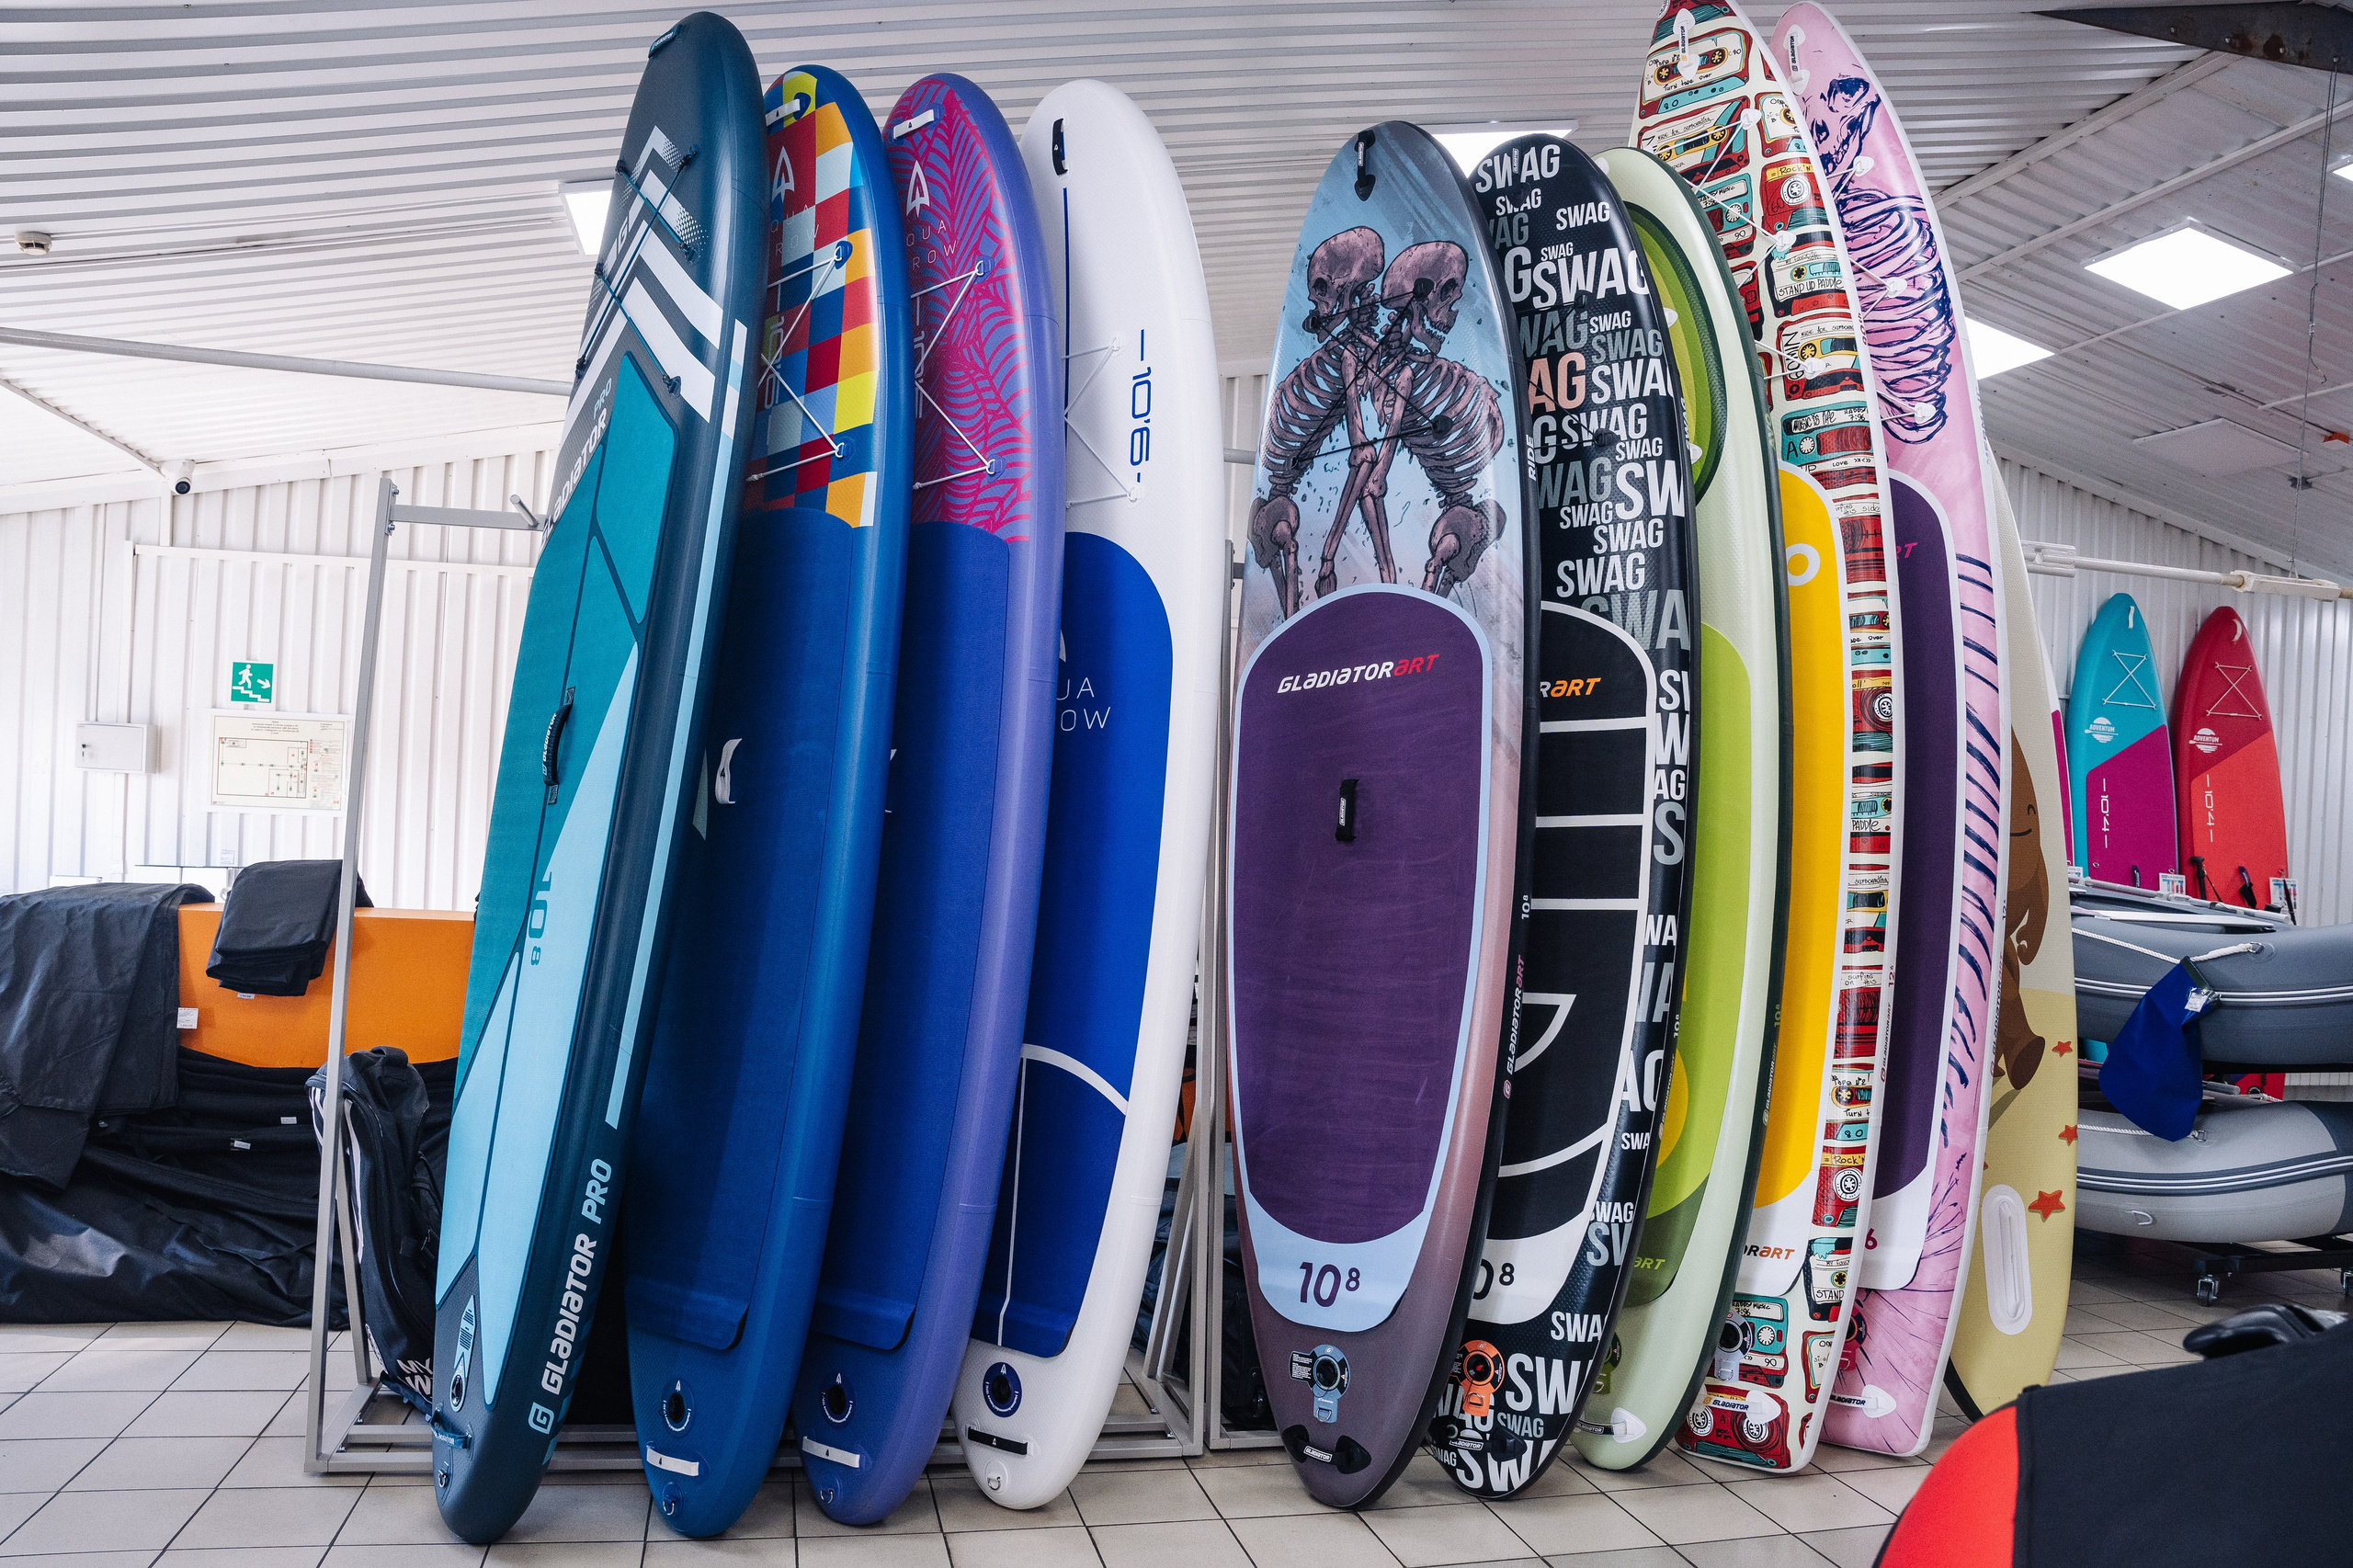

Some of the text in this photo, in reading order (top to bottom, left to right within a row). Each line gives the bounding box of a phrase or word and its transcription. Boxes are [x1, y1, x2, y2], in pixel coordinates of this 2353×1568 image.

[1475, 144, 1561, 194] SWAG
[1556, 201, 1610, 231] SWAG
[1734, 230, 1745, 240] 90
[1540, 242, 1574, 262] SWAG
[1779, 283, 1804, 296] STAND
[1589, 310, 1631, 334] SWAG
[1592, 328, 1663, 365] SWAG
[594, 377, 612, 421] PRO
[1532, 415, 1557, 464] G
[1562, 403, 1647, 450] SWAG
[1525, 434, 1537, 482] RIDE
[1615, 437, 1663, 460] SWAG
[1787, 441, 1798, 460] A
[1560, 500, 1614, 529] SWAG
[1593, 518, 1665, 554] SWAG
[1556, 551, 1646, 597] SWAG
[2089, 723, 2115, 733] ADVENTUM
[2193, 734, 2220, 743] ADVENTUM
[1654, 768, 1686, 801] AG
[1654, 801, 1686, 866] S
[1865, 1228, 1878, 1250] 6
[541, 1158, 612, 1395] GLADIATOR PRO
[1764, 1358, 1777, 1367] 90
[1712, 1399, 1749, 1411] GLADIATOR
